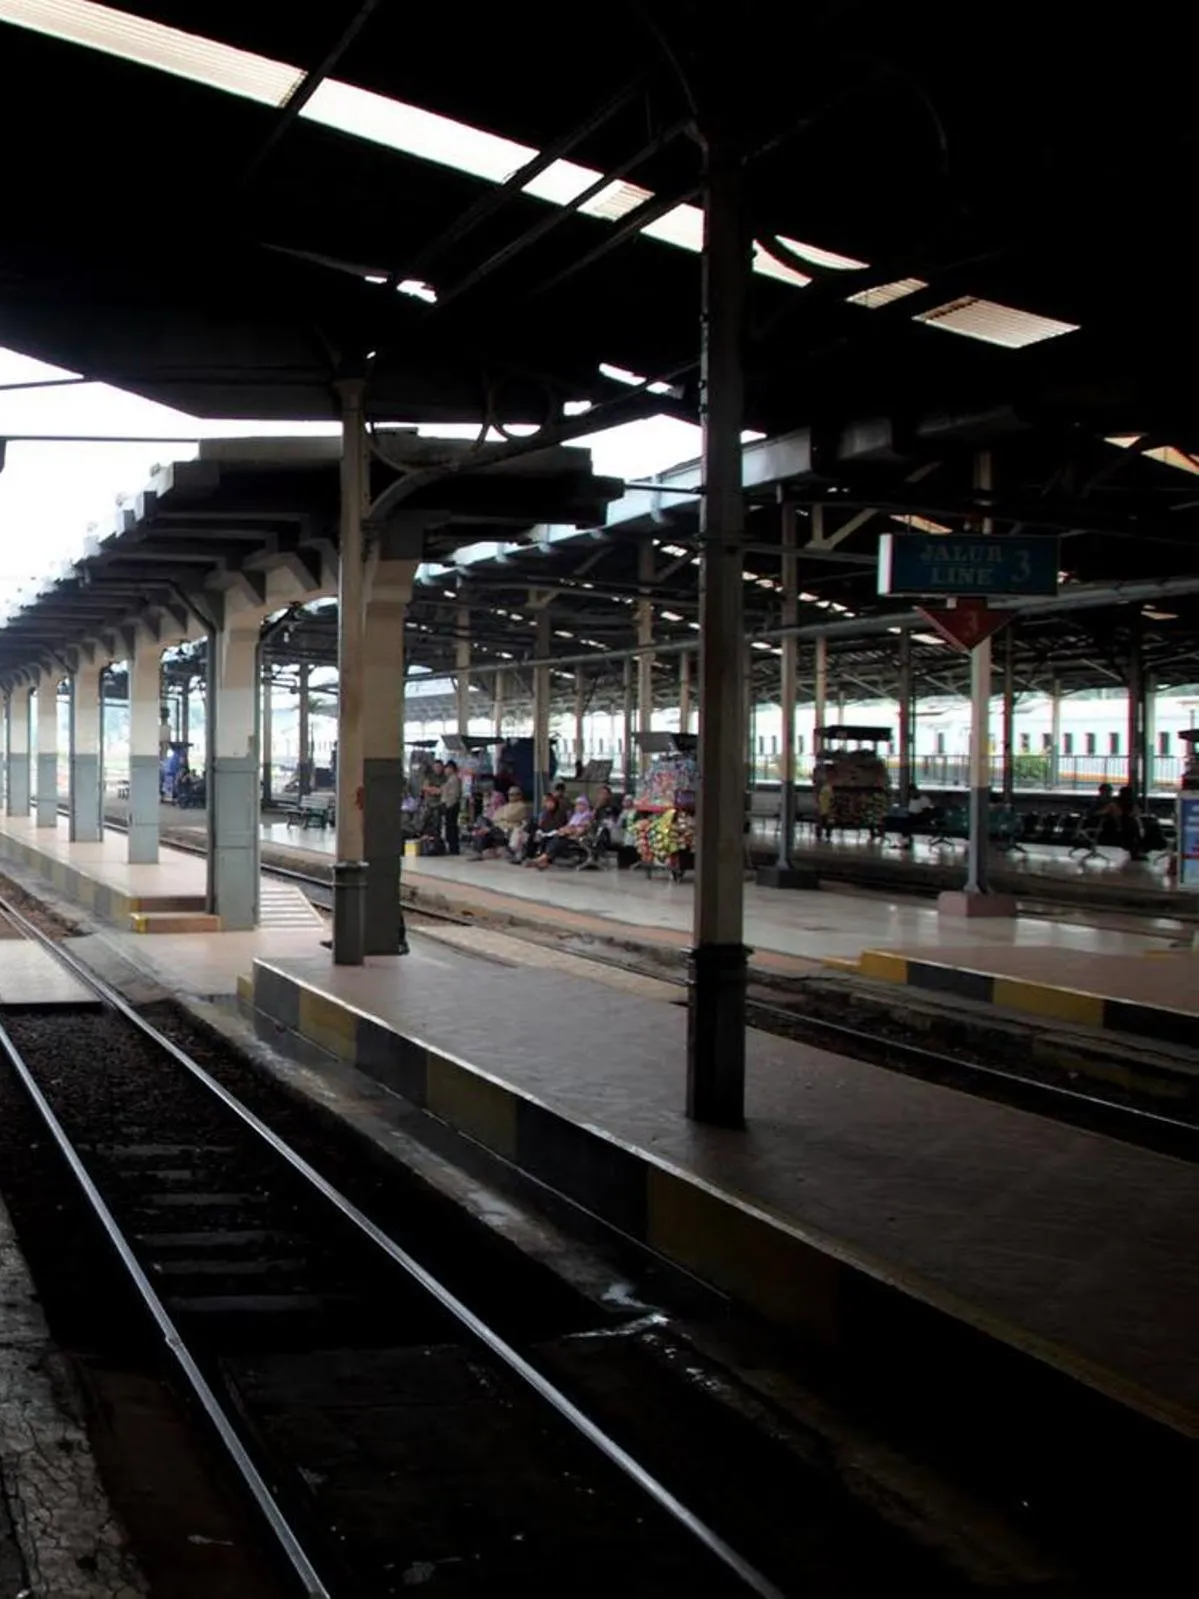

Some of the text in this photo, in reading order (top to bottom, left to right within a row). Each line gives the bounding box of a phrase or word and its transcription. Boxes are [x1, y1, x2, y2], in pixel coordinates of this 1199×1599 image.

[920, 544, 1003, 562] JALUR
[1011, 550, 1032, 583] 3
[931, 567, 994, 585] LINE
